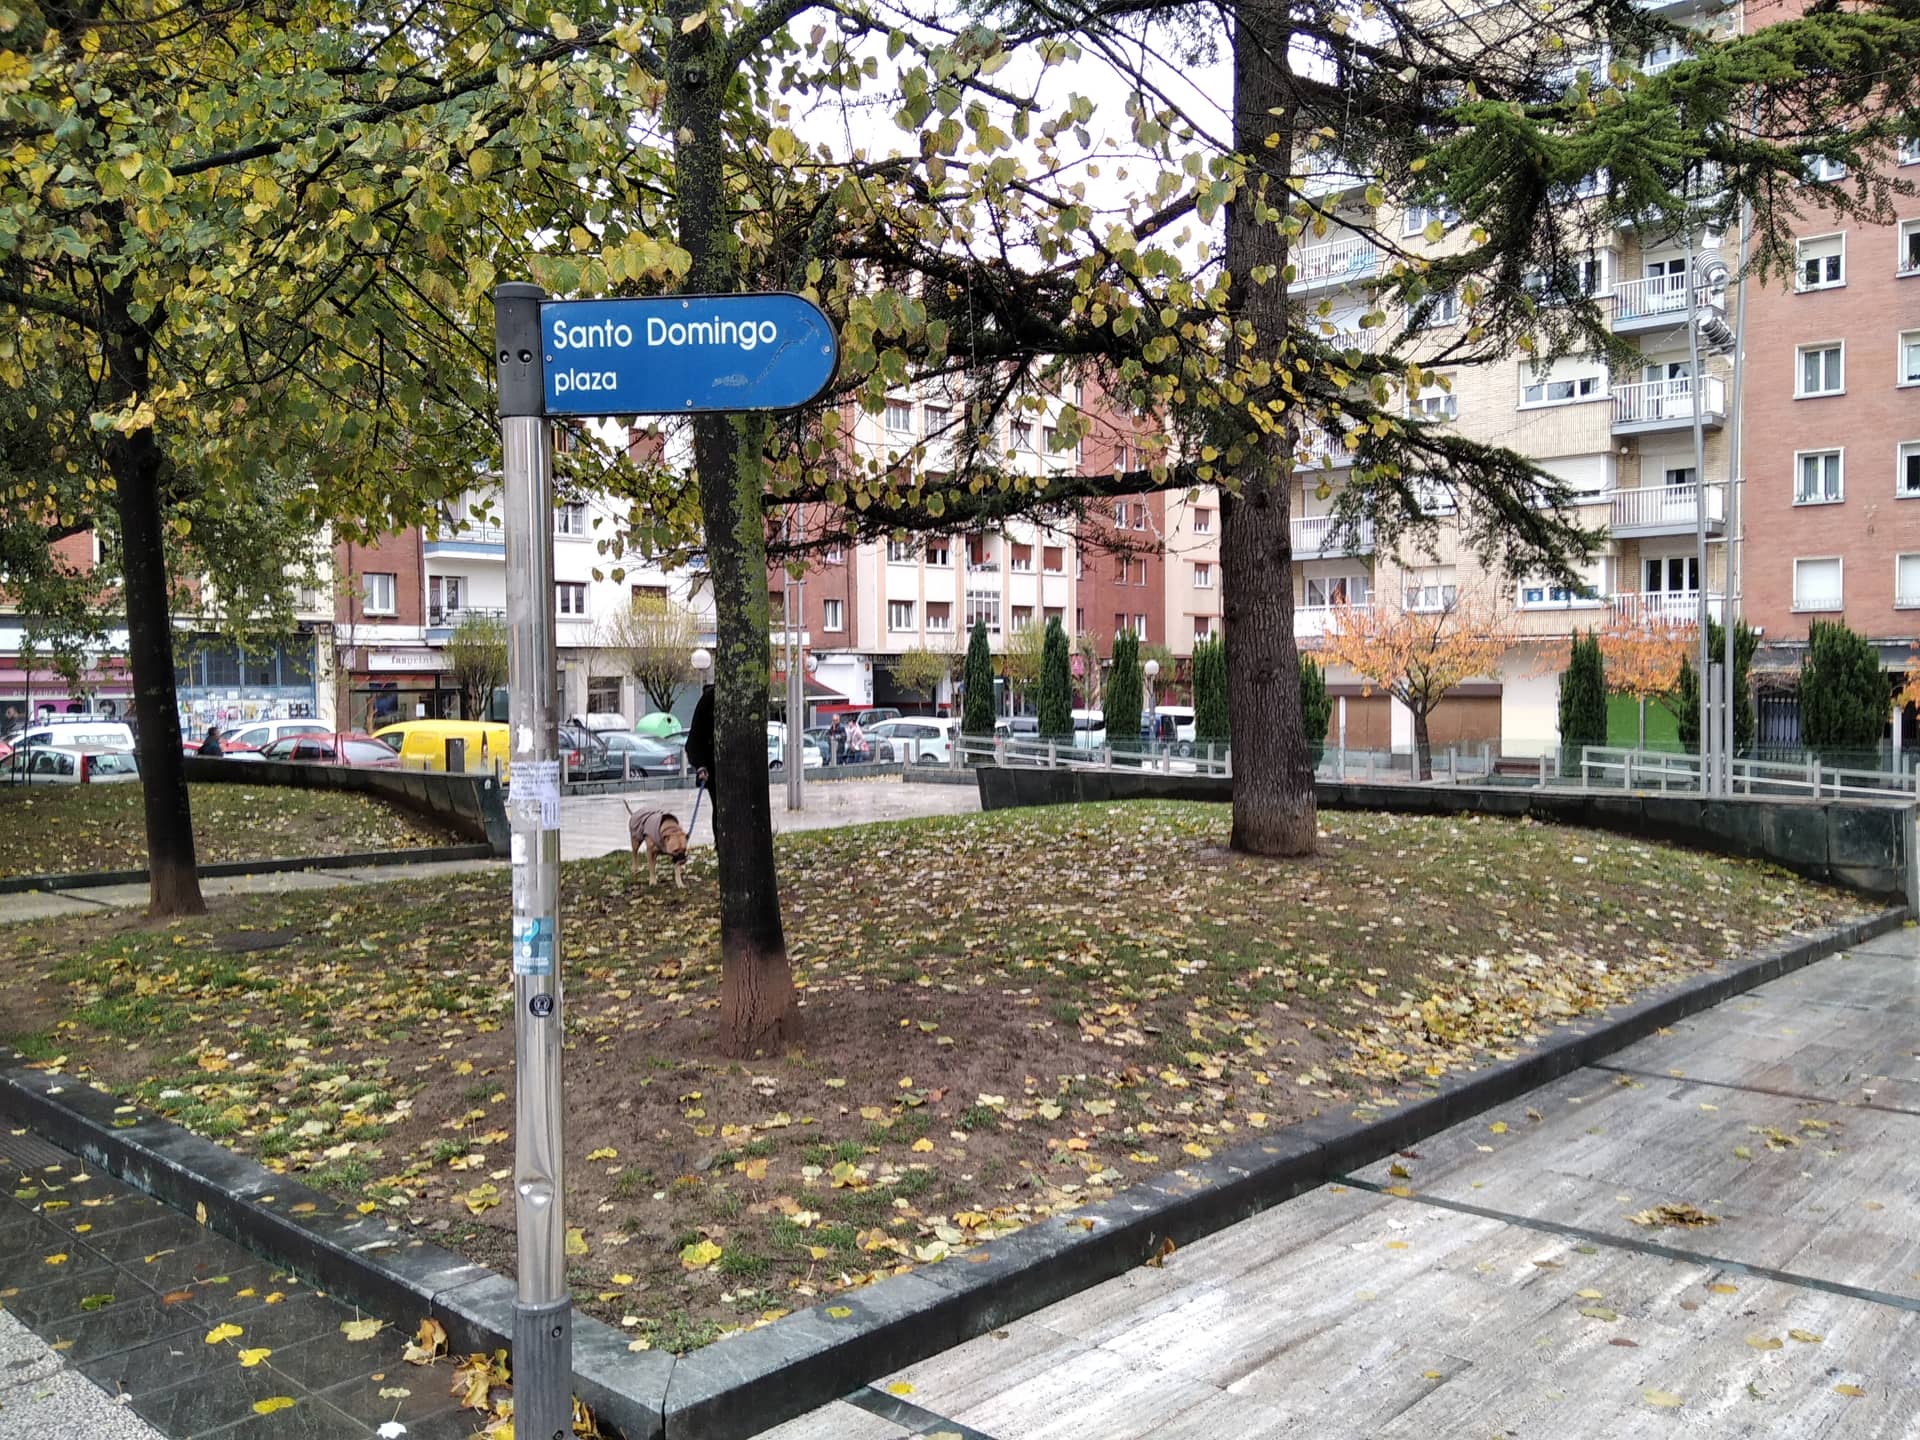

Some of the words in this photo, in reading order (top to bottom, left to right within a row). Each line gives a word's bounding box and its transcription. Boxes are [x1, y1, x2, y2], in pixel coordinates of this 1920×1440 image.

[553, 319, 633, 349] Santo
[647, 315, 777, 350] Domingo
[555, 368, 617, 396] plaza
